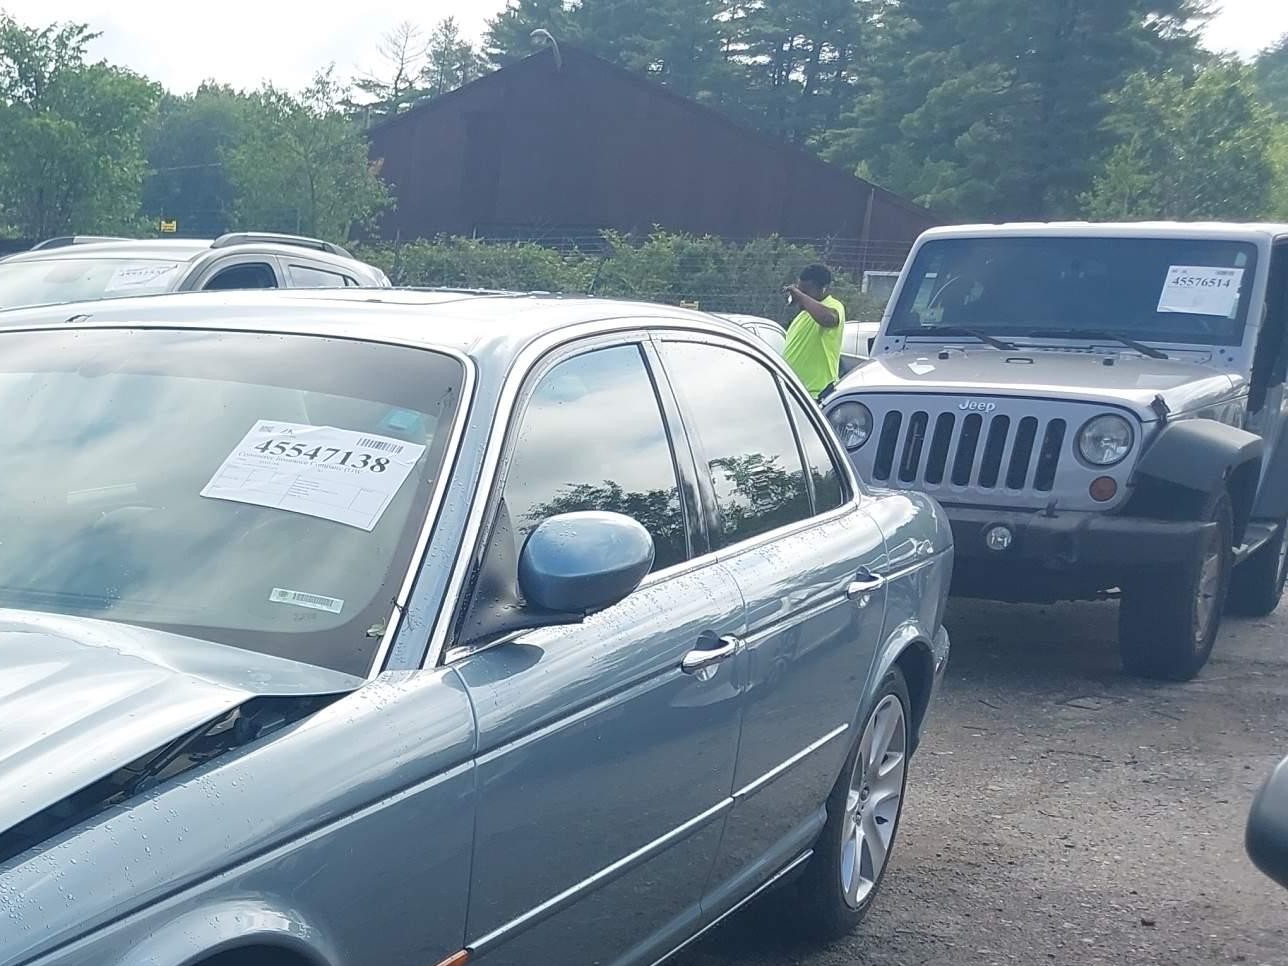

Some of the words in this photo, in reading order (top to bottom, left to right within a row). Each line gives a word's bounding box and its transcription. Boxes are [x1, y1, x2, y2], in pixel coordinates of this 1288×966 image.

[1172, 277, 1231, 288] 45576514
[959, 399, 996, 413] Jeep
[253, 439, 390, 473] 45547138
